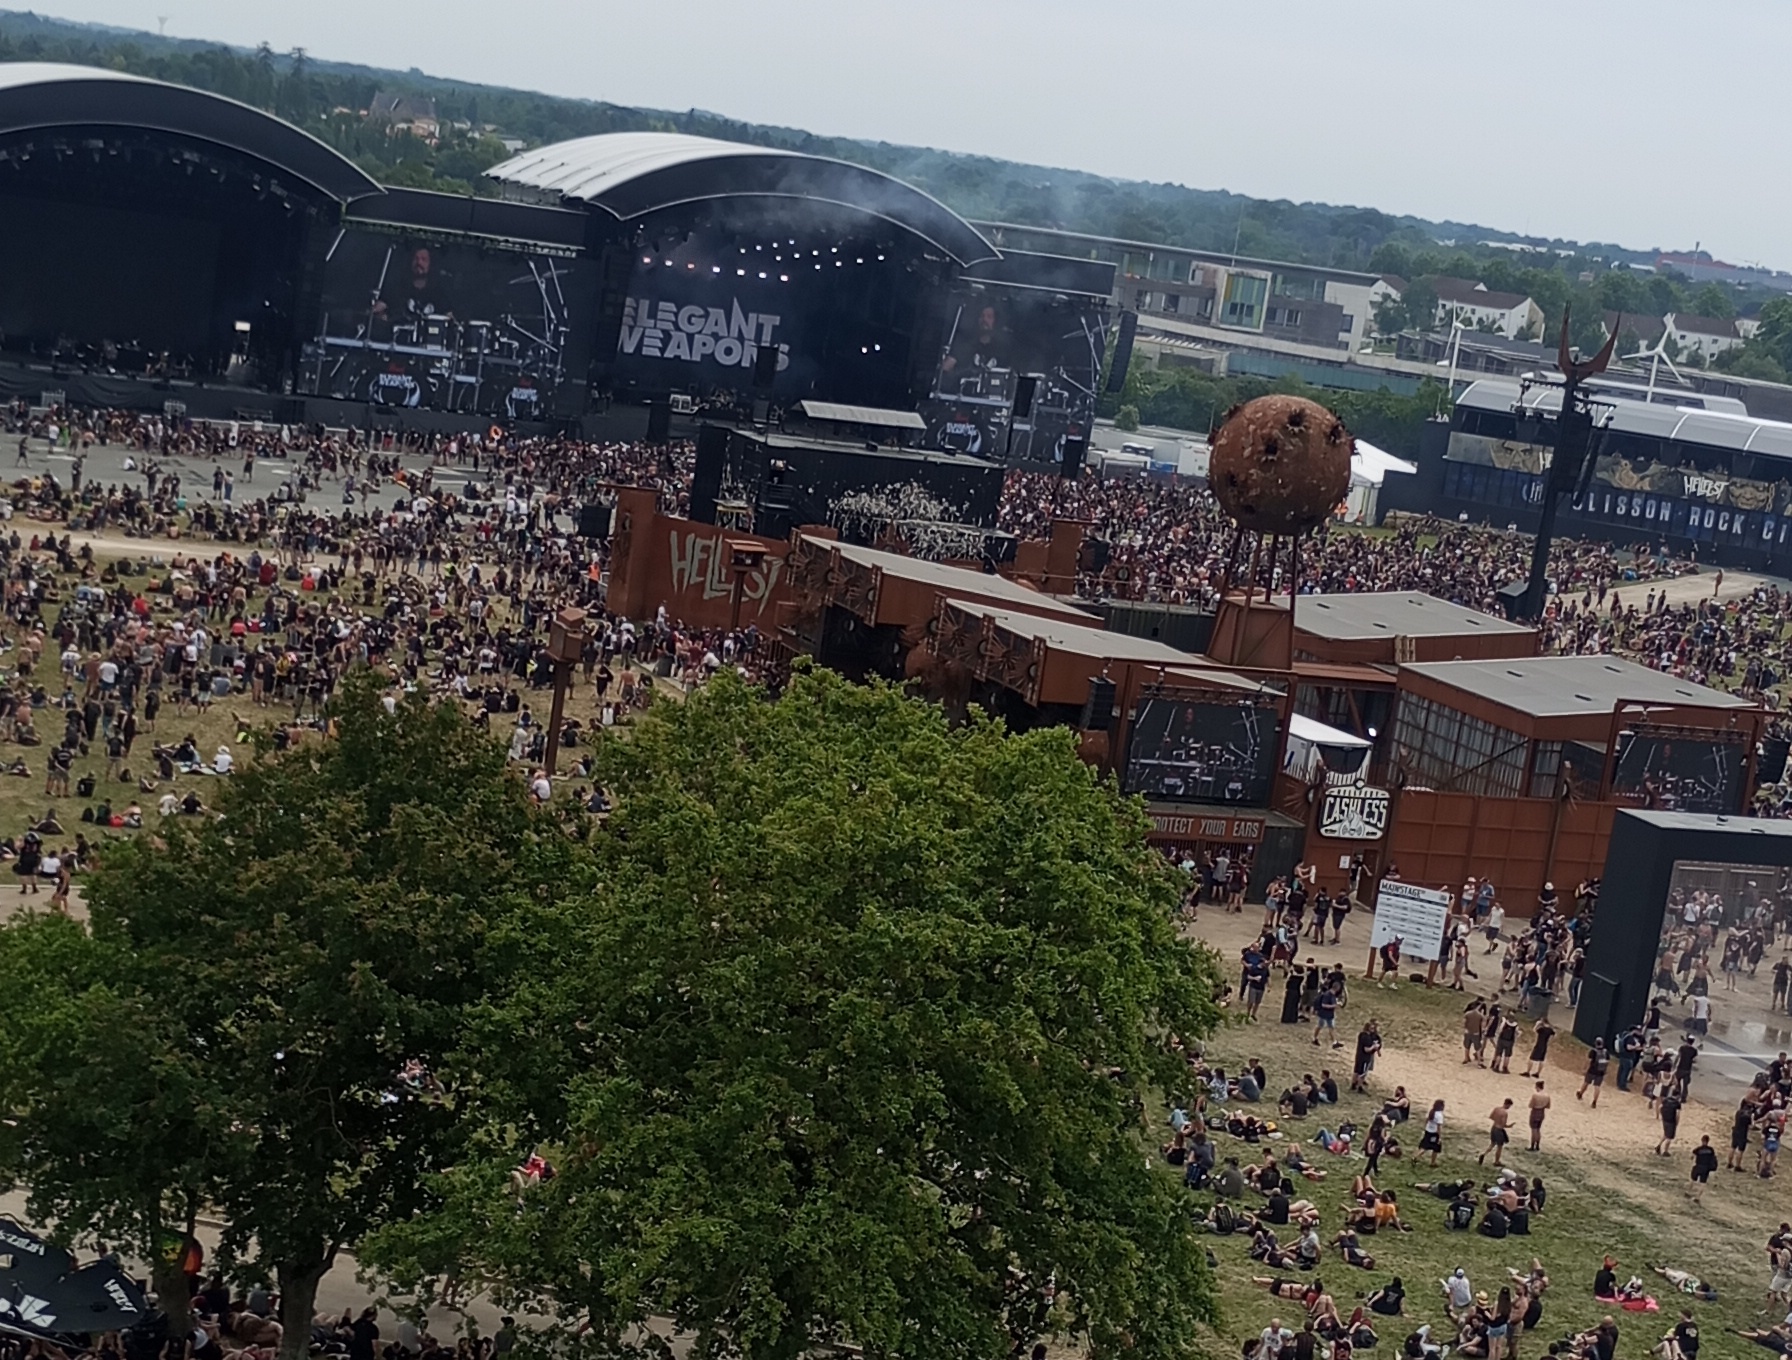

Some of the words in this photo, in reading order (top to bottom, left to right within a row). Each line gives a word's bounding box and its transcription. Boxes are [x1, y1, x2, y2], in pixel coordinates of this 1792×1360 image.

[623, 297, 781, 347] ELEGANT
[1683, 475, 1730, 500] HELLFEST
[1689, 506, 1746, 535] ROCK
[1151, 815, 1195, 835] ROTECT
[1200, 819, 1227, 837] YOUR
[1232, 820, 1259, 838] EARS
[1323, 797, 1389, 829] CASHLESS
